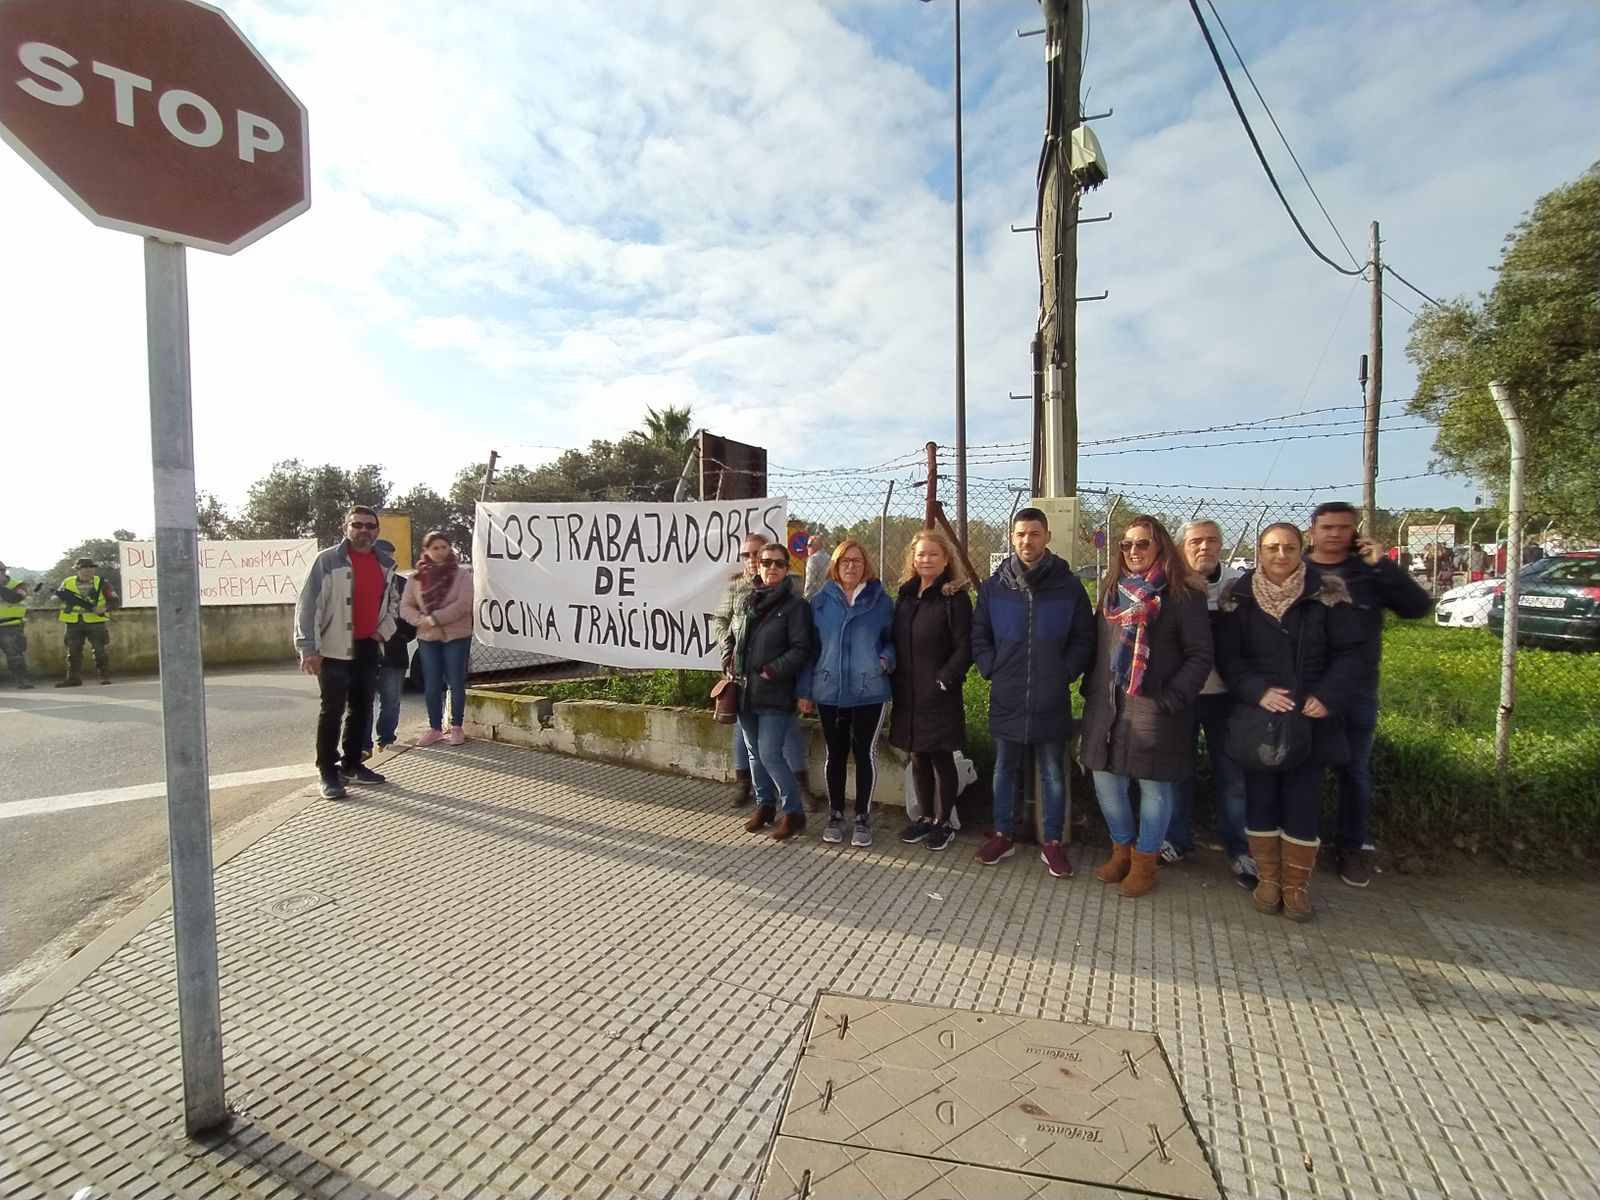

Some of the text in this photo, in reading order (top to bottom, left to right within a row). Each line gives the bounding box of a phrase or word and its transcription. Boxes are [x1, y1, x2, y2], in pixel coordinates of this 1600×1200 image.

[16, 41, 284, 163] STOP
[487, 514, 543, 562] LOS
[261, 550, 306, 567] MATA
[218, 575, 297, 597] REMATA
[595, 566, 635, 597] DE
[479, 599, 562, 642] COCINA
